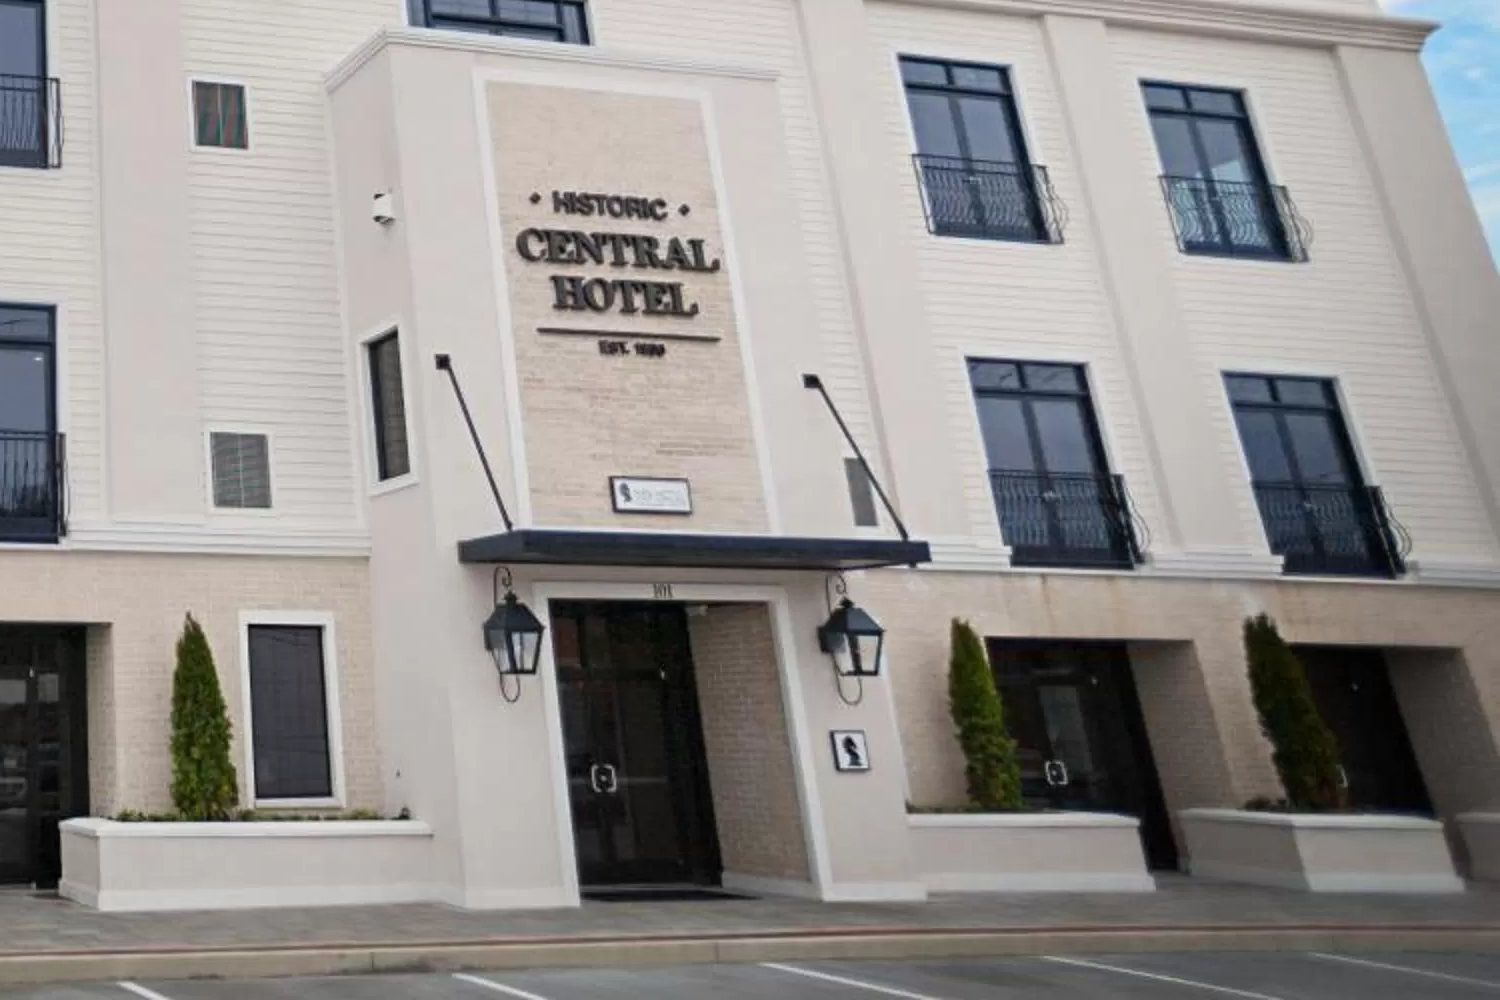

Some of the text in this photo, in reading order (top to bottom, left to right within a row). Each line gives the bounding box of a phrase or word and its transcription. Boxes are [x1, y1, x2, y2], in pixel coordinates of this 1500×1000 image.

[552, 190, 668, 221] HISTORIC
[516, 227, 720, 273] CENTRAL
[549, 275, 699, 317] HOTEL
